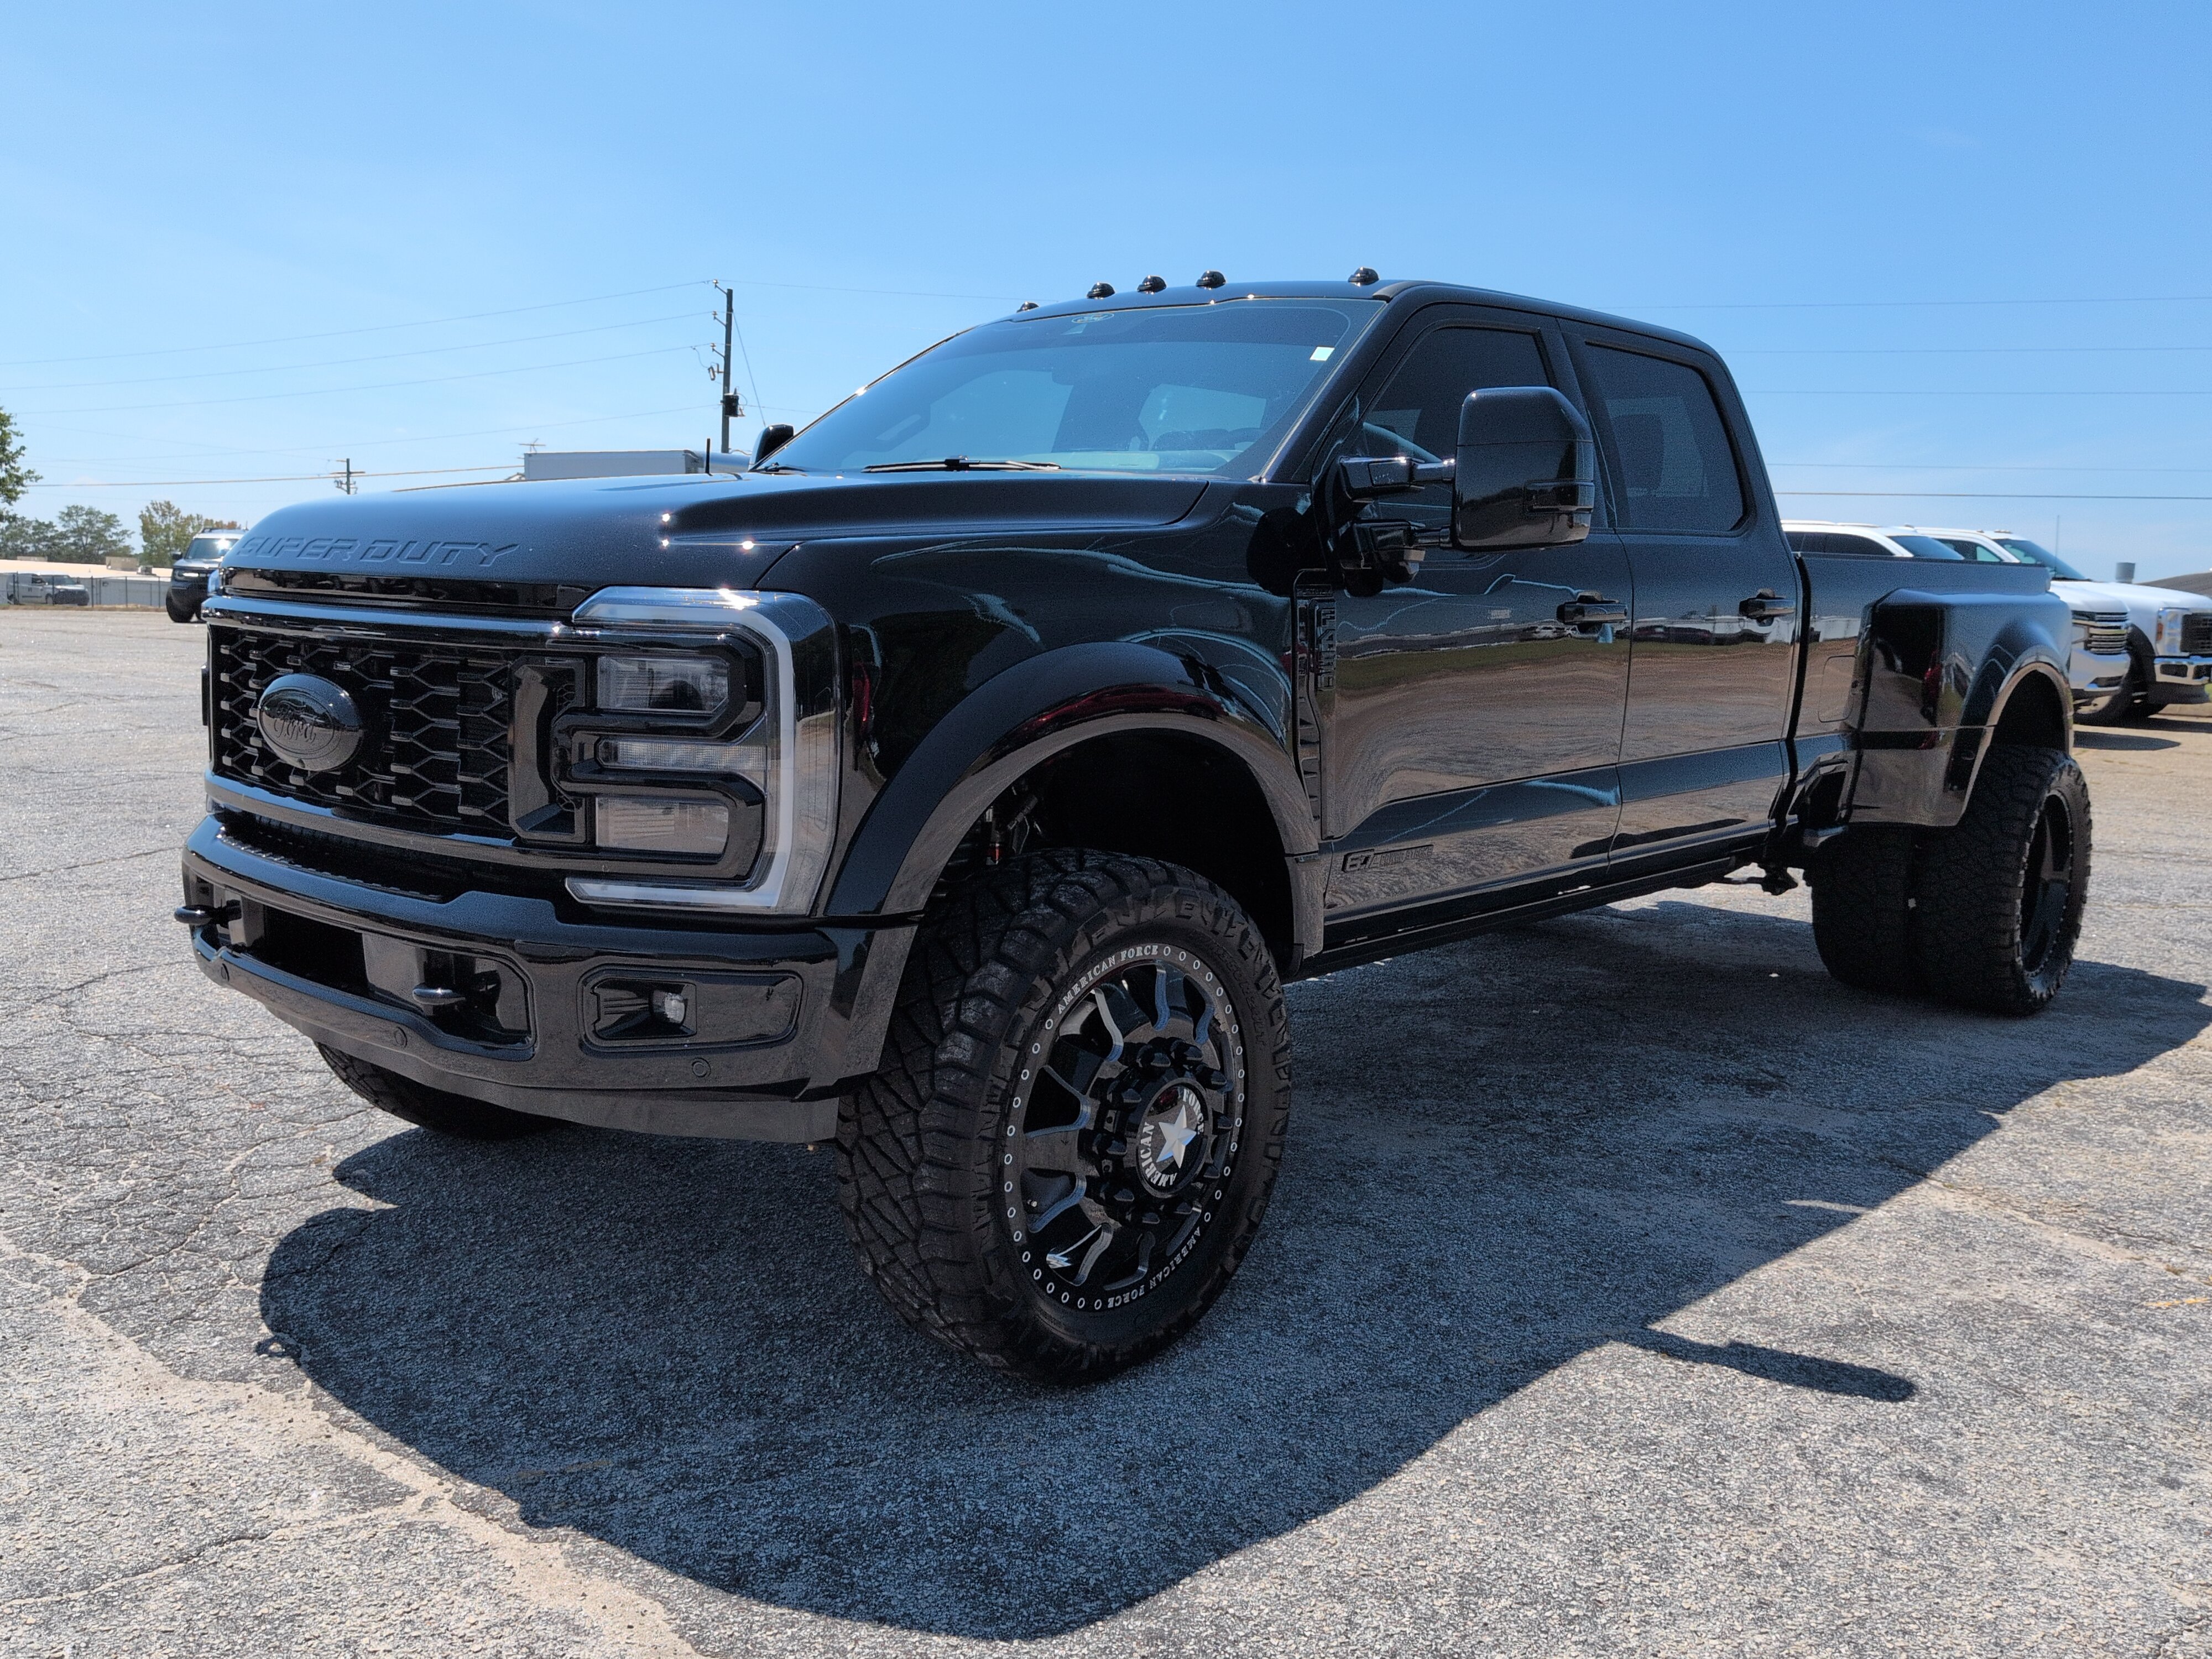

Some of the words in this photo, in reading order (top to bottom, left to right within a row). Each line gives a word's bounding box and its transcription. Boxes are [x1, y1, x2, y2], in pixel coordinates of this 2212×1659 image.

[237, 536, 360, 561] SUPER
[358, 540, 520, 567] DUTY
[1406, 846, 1433, 859] STROKE
[1057, 954, 1116, 1014] AMERICAN
[1120, 945, 1159, 962] FORCE
[1140, 1121, 1178, 1187] AMERICAN
[1182, 1087, 1204, 1135] FORCE
[1150, 1226, 1201, 1288] AMERICAN
[1108, 1283, 1145, 1308] FORCE
